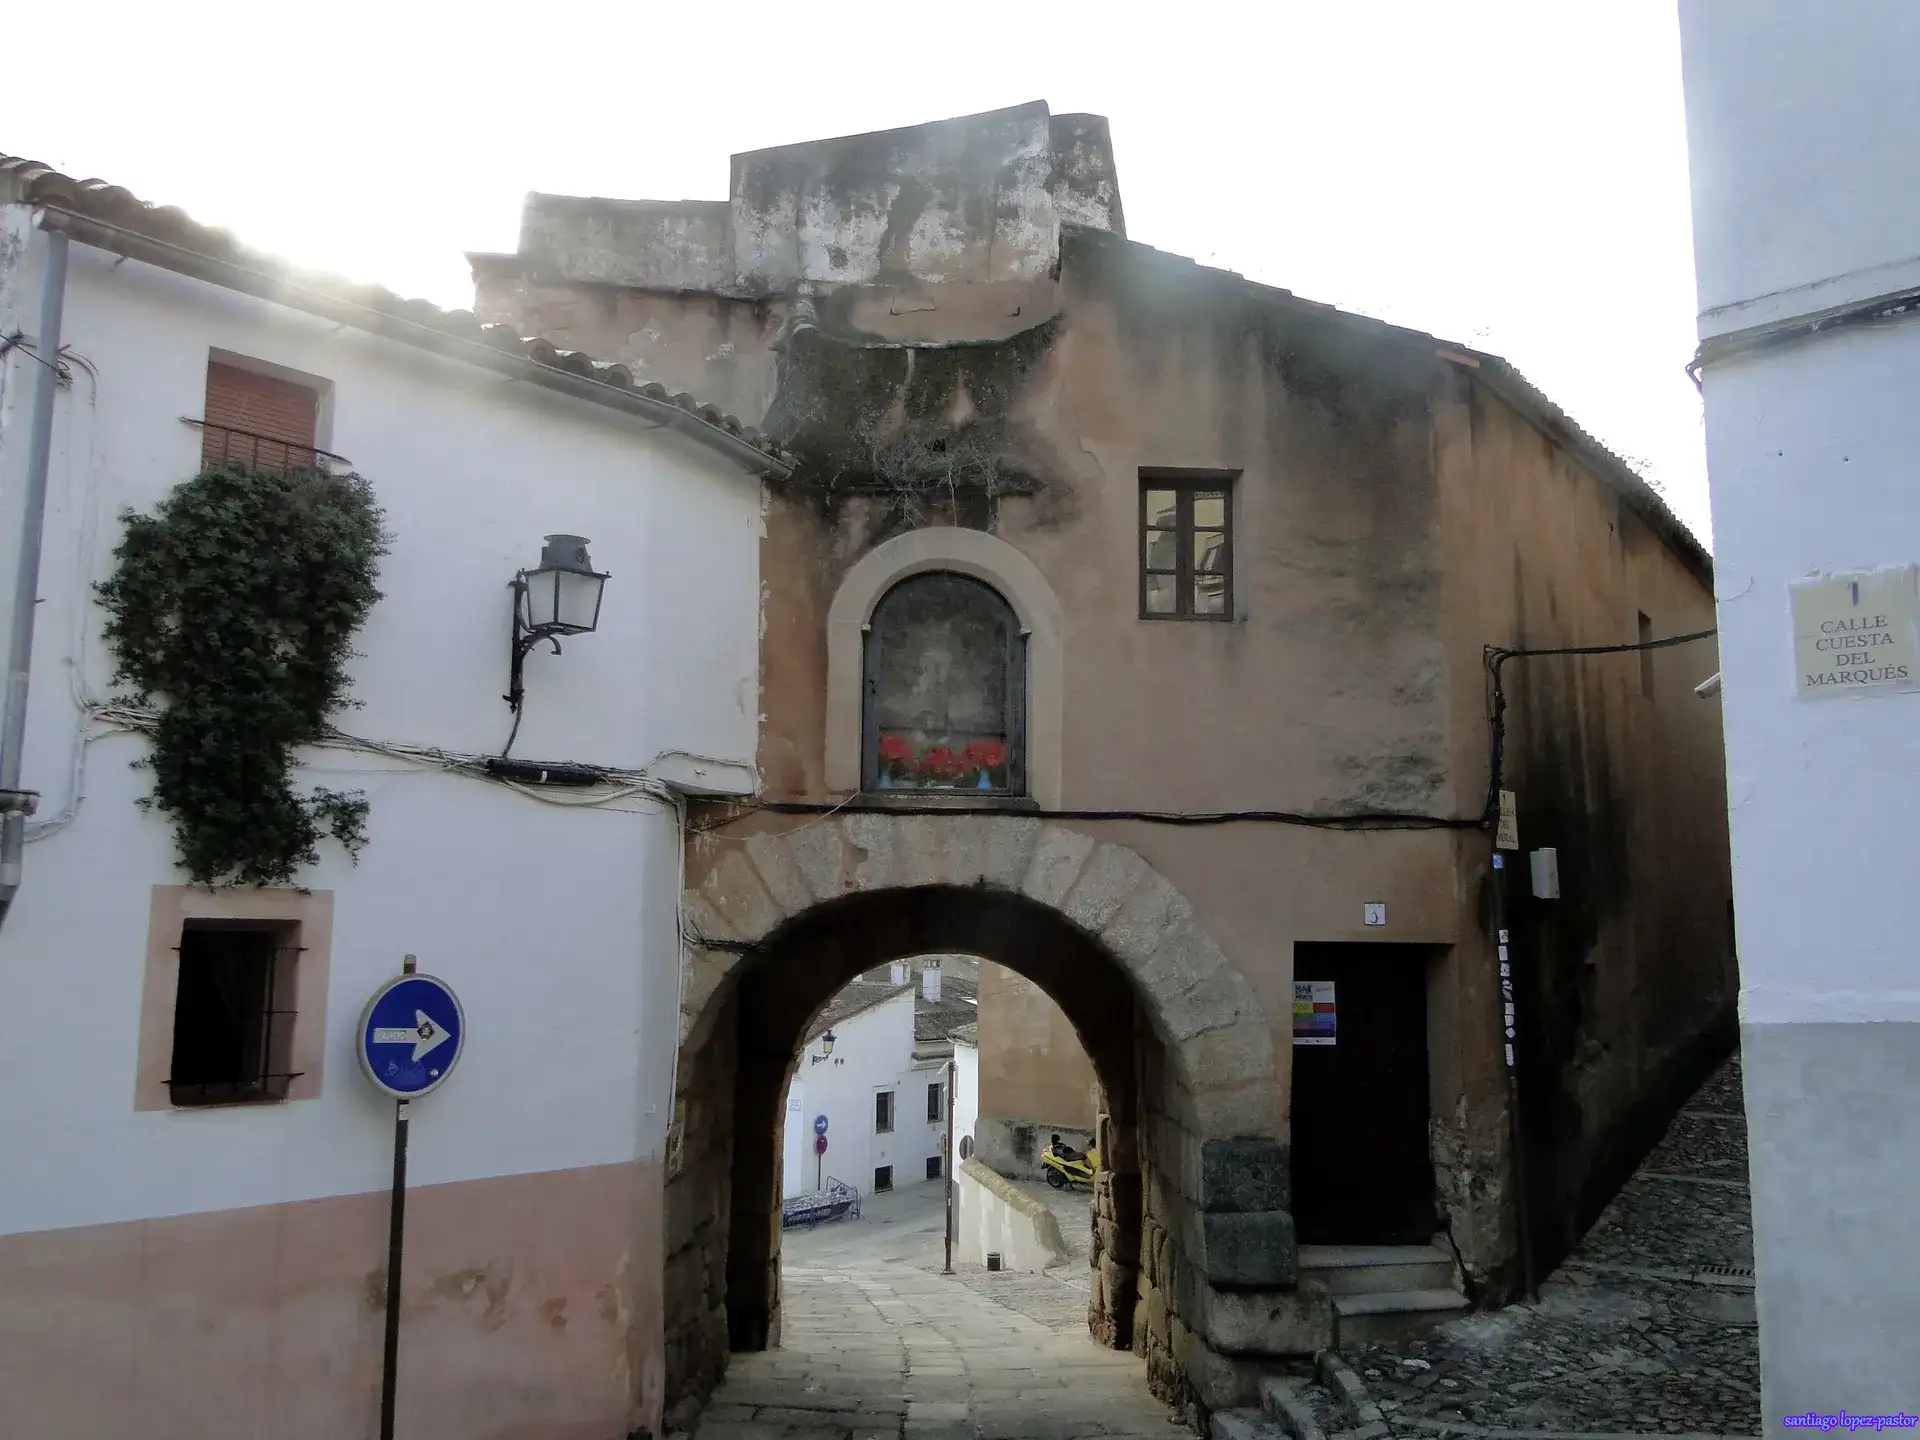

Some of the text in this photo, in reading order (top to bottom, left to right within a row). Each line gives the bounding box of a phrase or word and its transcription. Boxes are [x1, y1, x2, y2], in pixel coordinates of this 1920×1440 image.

[1820, 615, 1888, 633] CALLE
[1816, 633, 1894, 651] CUESTA
[1835, 652, 1875, 666] DEL
[1806, 664, 1908, 686] MARQUÉS
